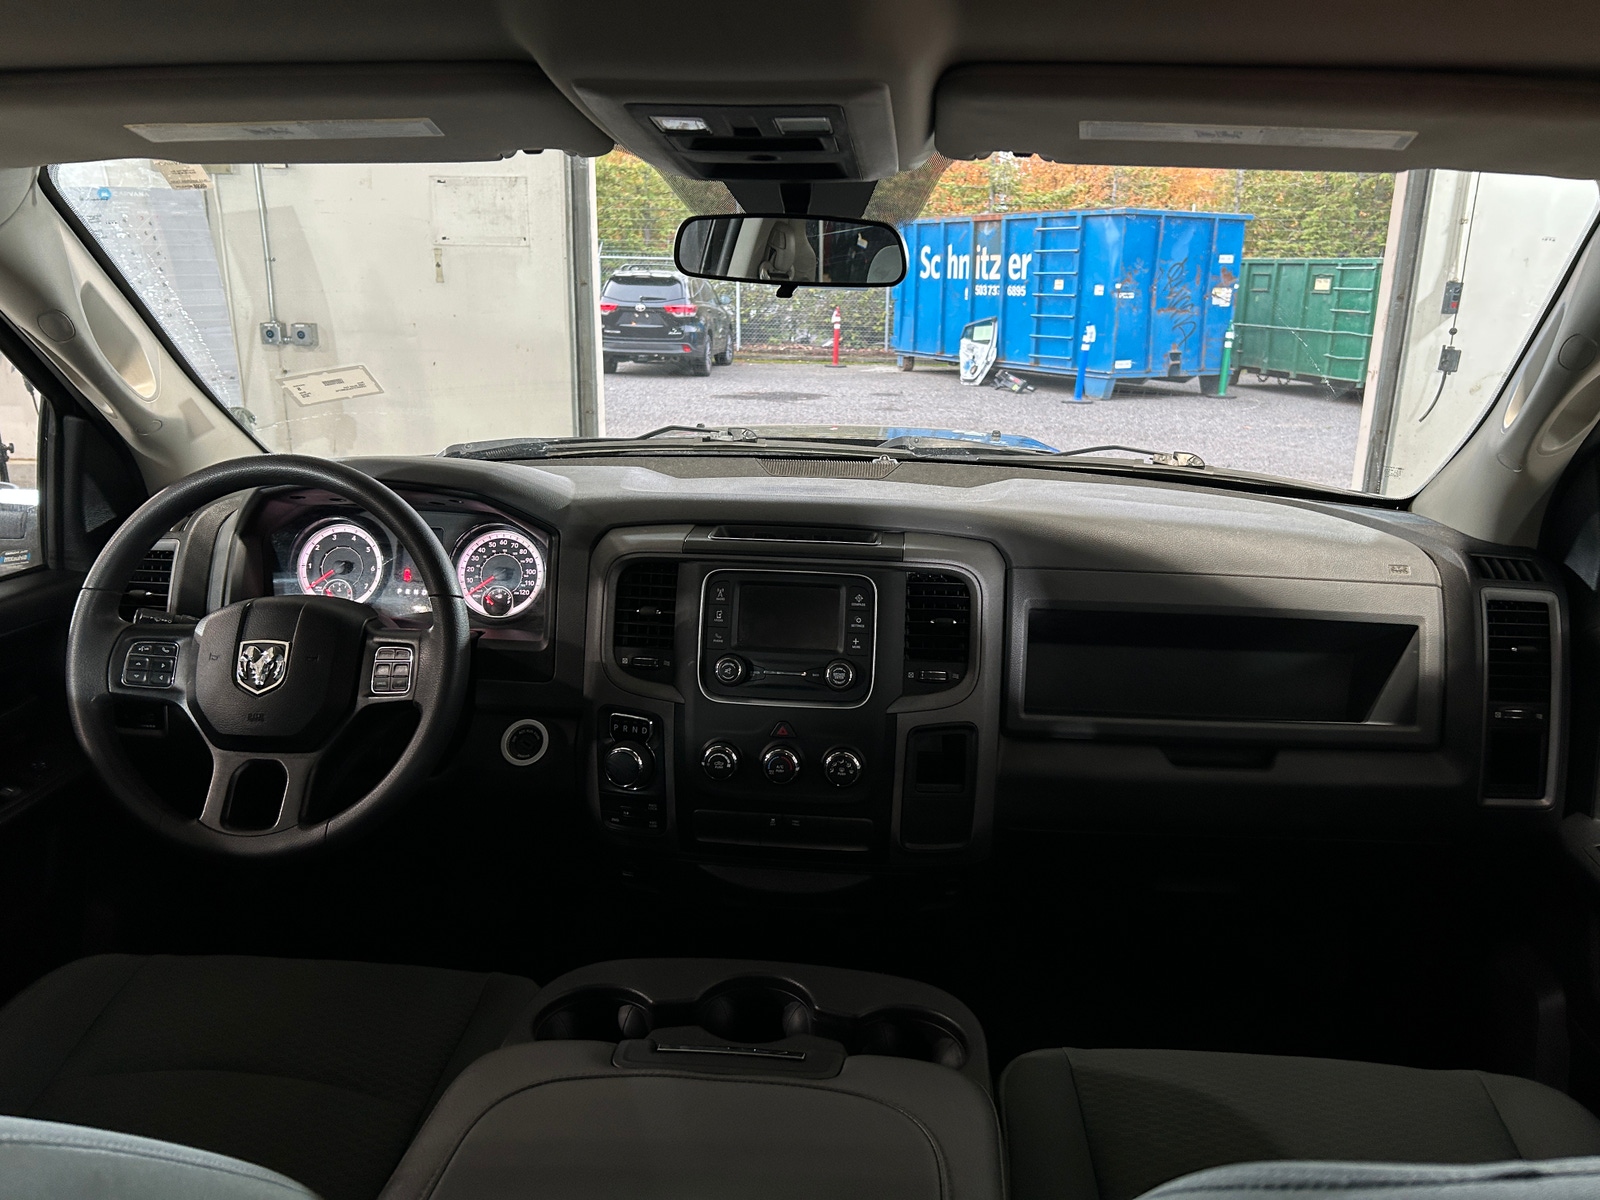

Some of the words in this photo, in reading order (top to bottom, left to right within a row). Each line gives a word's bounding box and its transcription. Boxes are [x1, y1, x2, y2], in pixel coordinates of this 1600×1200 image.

[623, 724, 629, 732] R
[632, 726, 638, 734] N
[642, 726, 648, 734] D
